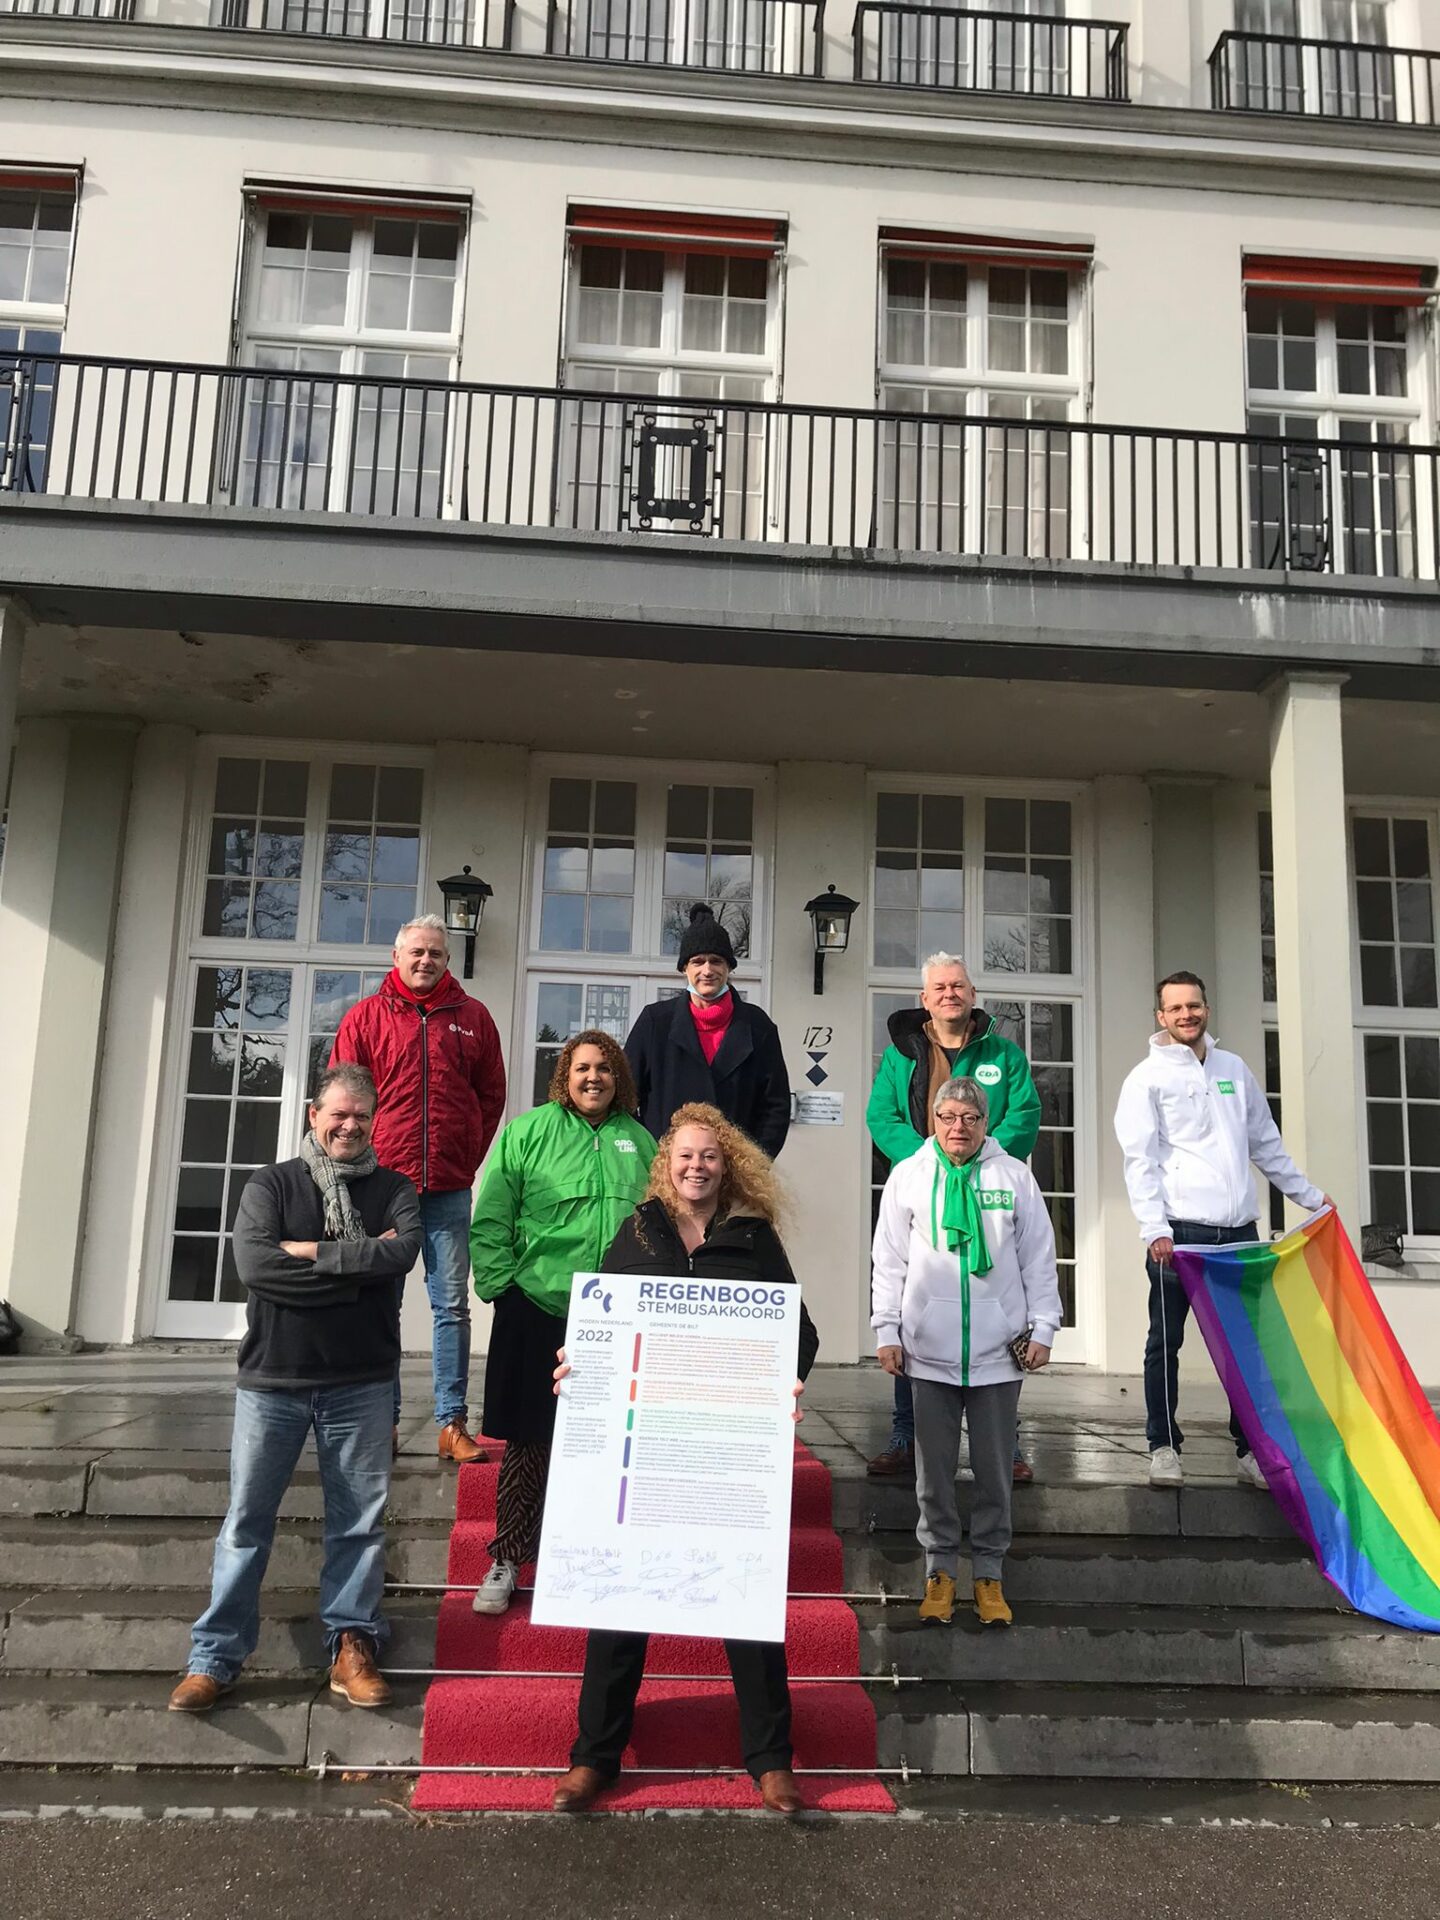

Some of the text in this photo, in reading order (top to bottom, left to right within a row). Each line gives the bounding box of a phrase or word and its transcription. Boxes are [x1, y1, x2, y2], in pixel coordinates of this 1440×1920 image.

[803, 1027, 833, 1048] 173
[978, 1070, 999, 1078] CDA
[982, 1191, 1010, 1205] D66
[639, 1282, 786, 1306] REGENBOOG
[637, 1301, 786, 1320] STEMBUSAKKOORD
[576, 1329, 613, 1342] 2022
